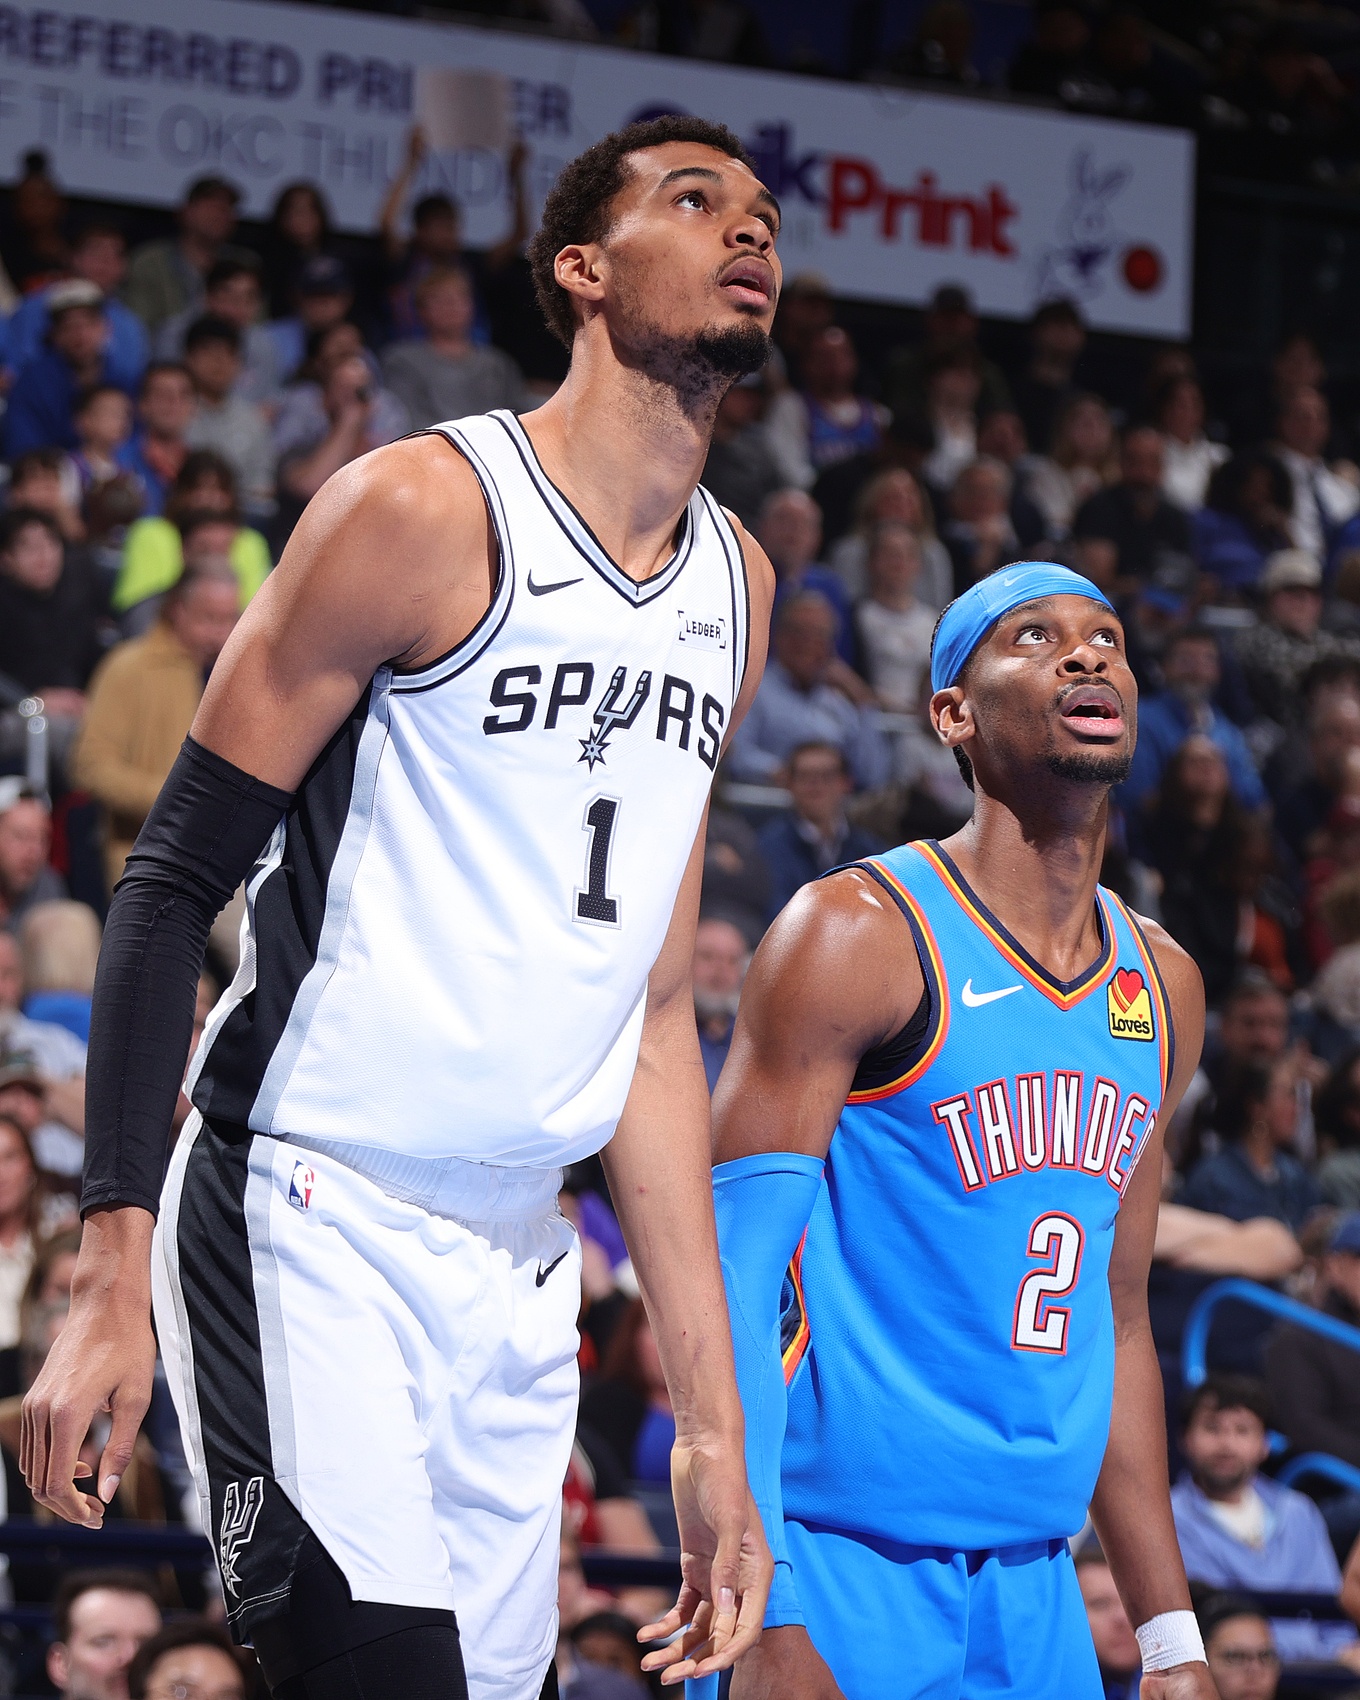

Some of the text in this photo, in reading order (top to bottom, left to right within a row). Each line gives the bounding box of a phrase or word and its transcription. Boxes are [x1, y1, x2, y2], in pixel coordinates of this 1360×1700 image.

[36, 83, 148, 161] THE
[158, 103, 286, 178] OKC
[317, 51, 573, 138] PRIER
[685, 619, 721, 640] LEDGER
[483, 662, 725, 774] SPURS
[572, 793, 622, 930] 1
[1010, 1210, 1085, 1355] 2
